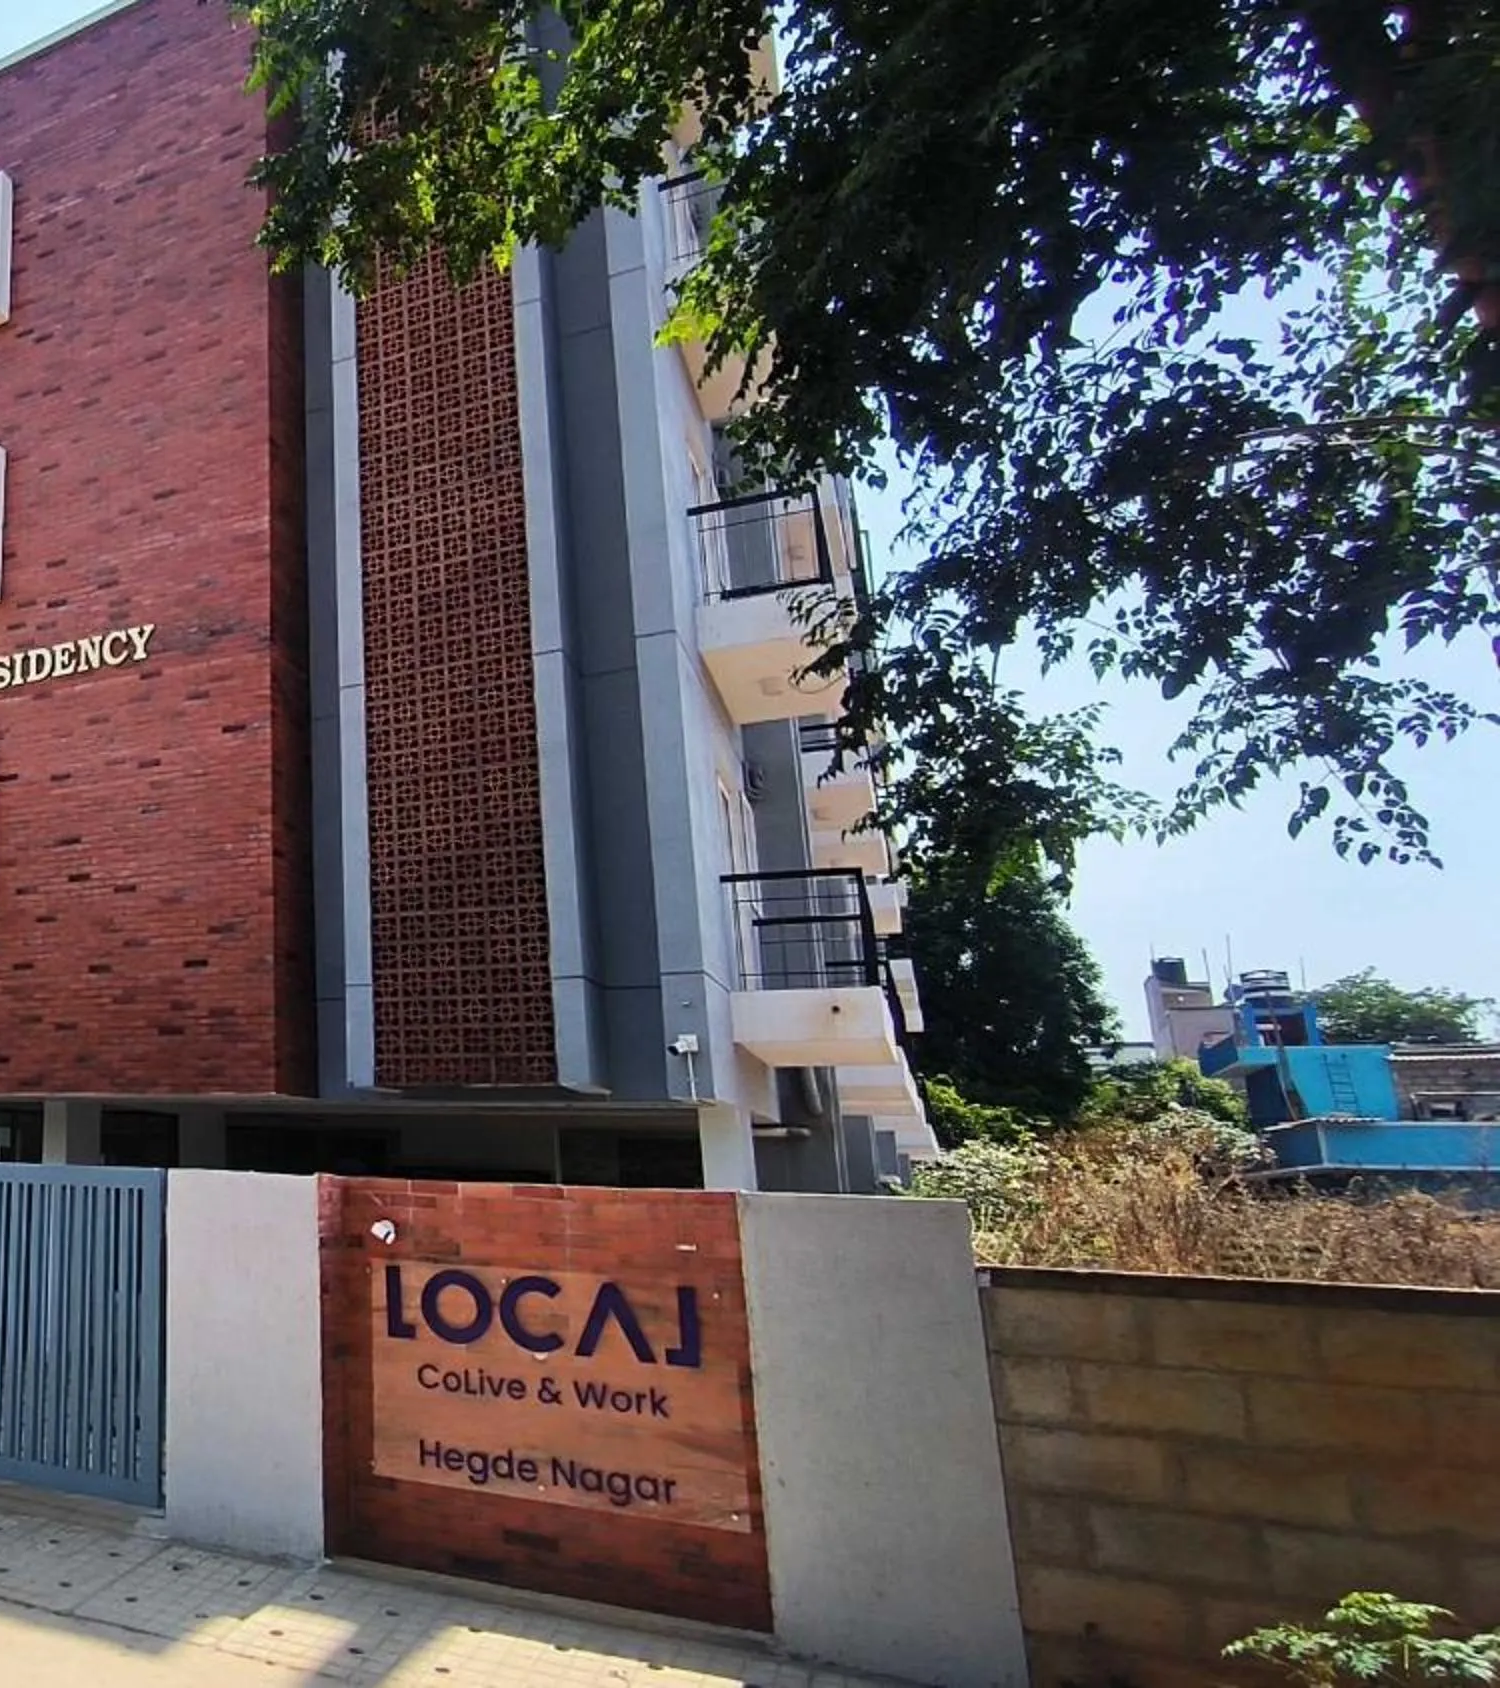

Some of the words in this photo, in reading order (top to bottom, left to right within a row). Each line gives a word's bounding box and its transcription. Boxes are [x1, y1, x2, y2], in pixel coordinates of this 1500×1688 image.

[386, 1265, 703, 1368] LOCAL
[416, 1364, 527, 1400] CoLive
[537, 1378, 564, 1406] &
[573, 1380, 669, 1418] Work
[418, 1439, 539, 1485] Hegde
[550, 1457, 677, 1507] Nagar
